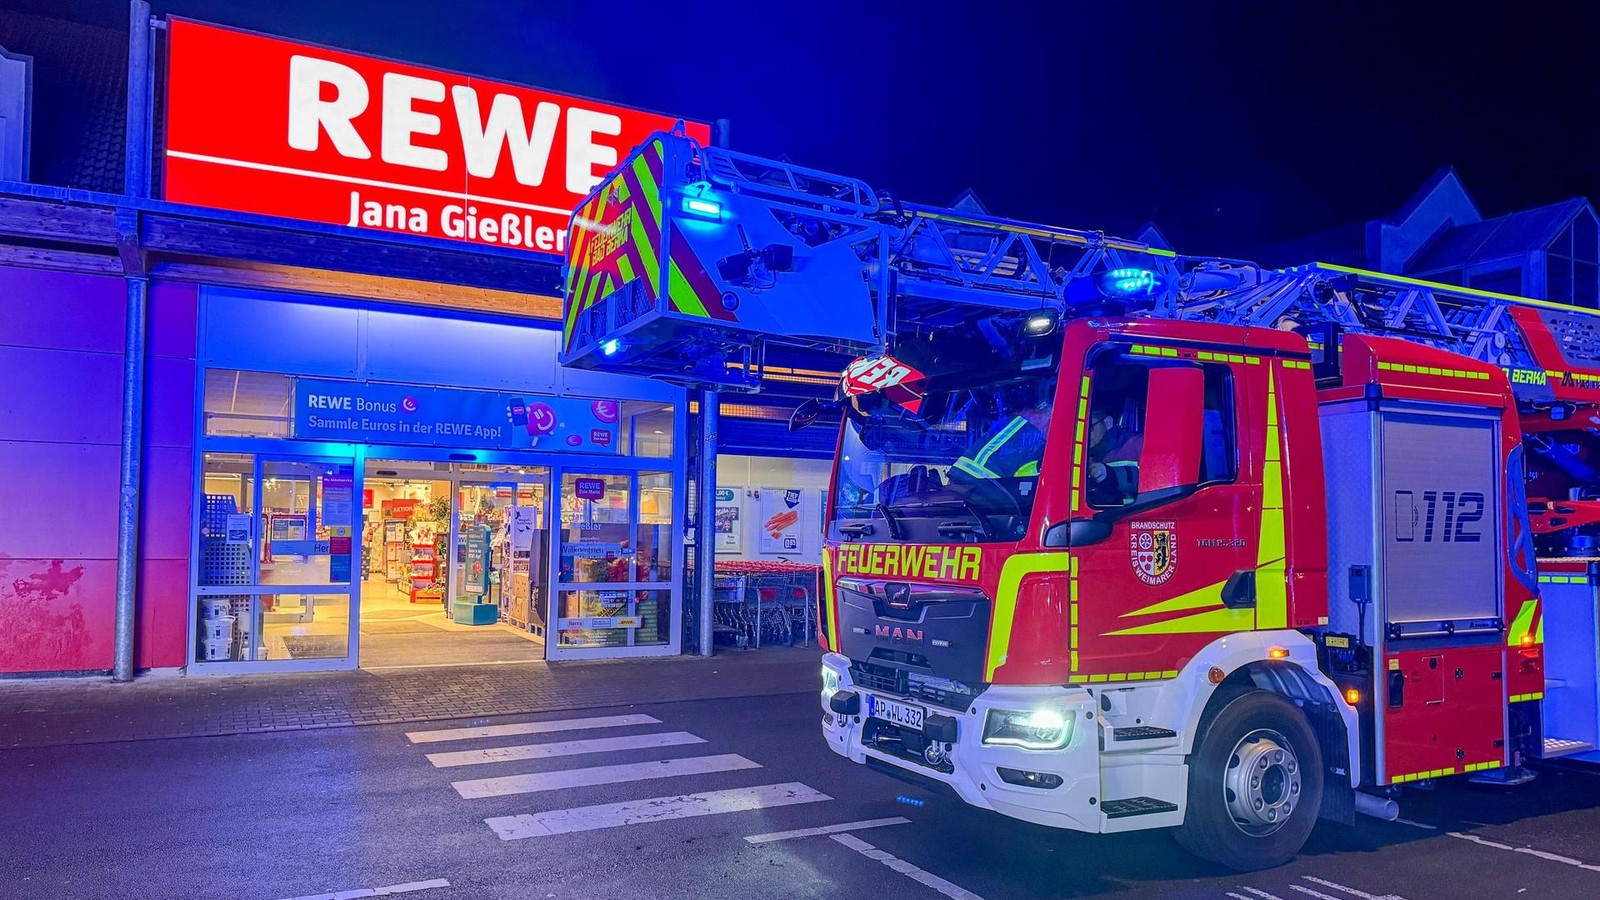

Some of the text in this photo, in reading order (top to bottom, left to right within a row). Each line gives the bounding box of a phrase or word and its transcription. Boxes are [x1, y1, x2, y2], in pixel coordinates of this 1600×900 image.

[288, 54, 622, 194] REWE
[347, 191, 568, 252] Jana Gießler
[591, 207, 632, 253] FEUERWEHR
[592, 243, 605, 267] BAD
[1511, 368, 1547, 386] BERKA
[308, 394, 397, 413] REWE Bonus
[308, 415, 501, 439] Sammle Euros in der REWE App!
[393, 505, 413, 514] AKTION
[1423, 490, 1485, 542] 112
[1131, 521, 1175, 530] BRANDSCHUTZ
[1130, 533, 1139, 568] KREIS
[1170, 533, 1178, 564] LAND
[837, 544, 982, 581] FEUERWEHR
[1135, 565, 1176, 585] WEIMARER
[875, 624, 923, 642] MAN
[876, 700, 886, 717] AP
[904, 707, 922, 728] 332
